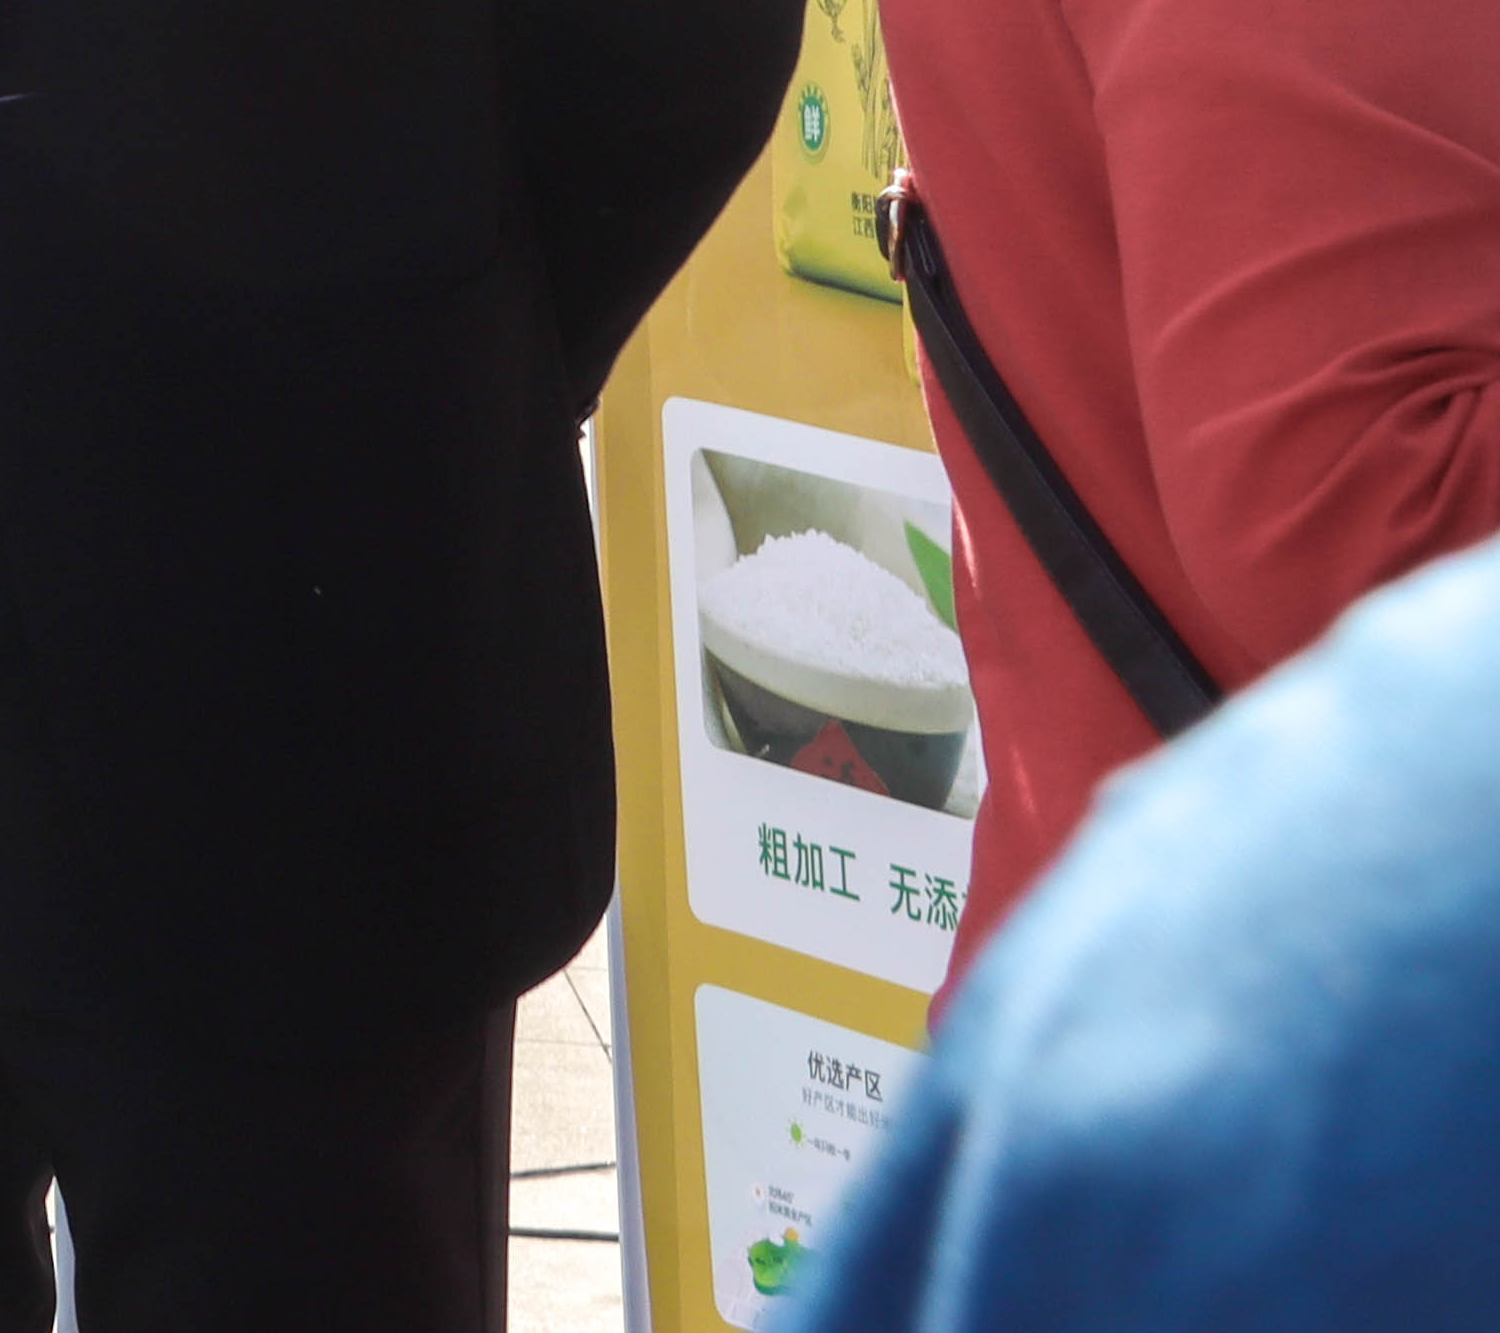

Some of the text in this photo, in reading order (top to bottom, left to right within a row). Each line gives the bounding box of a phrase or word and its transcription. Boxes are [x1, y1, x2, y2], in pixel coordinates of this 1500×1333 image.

[757, 822, 971, 932] 粗加工 无添
[807, 1049, 884, 1102] 优选产区
